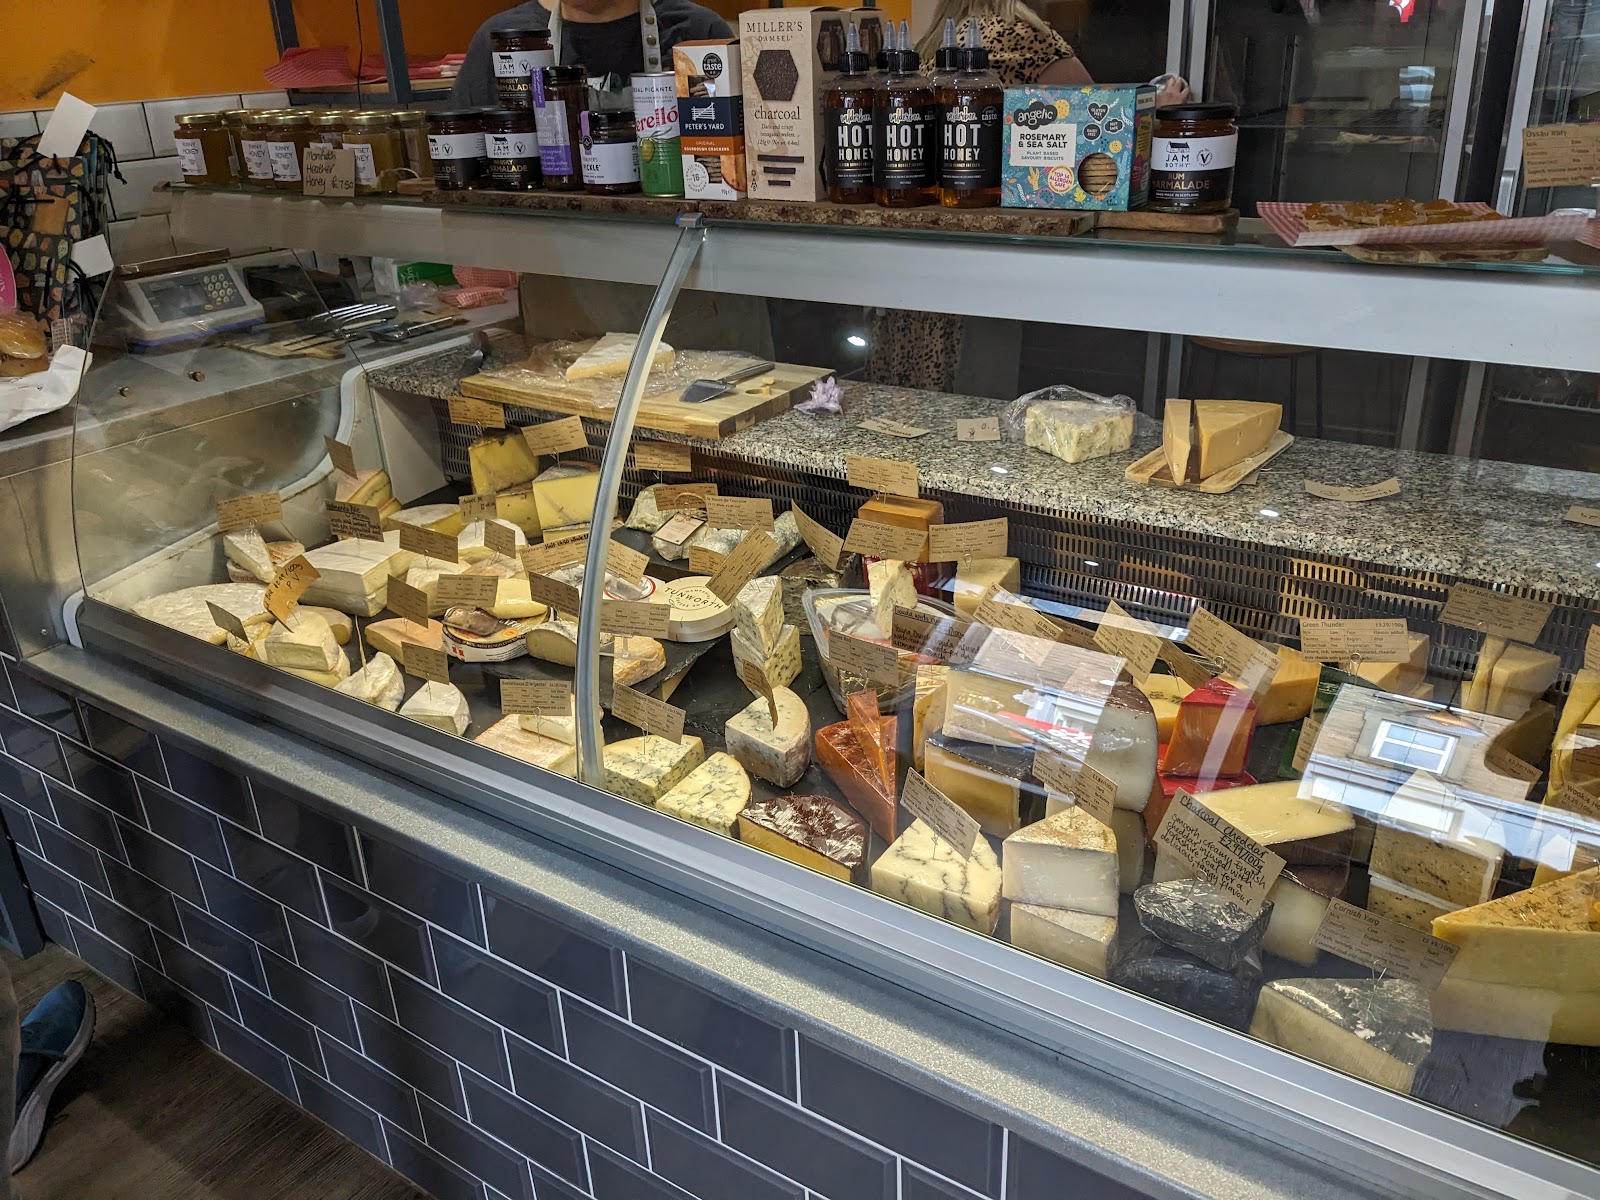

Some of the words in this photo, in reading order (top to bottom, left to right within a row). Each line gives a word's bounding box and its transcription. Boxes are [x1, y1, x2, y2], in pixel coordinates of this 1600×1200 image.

[746, 20, 803, 32] MILLER'S
[703, 62, 722, 71] taste
[636, 105, 679, 132] erelló
[754, 106, 801, 120] charcoal
[981, 113, 998, 121] taste
[1018, 108, 1054, 125] angelic
[780, 124, 794, 132] crispy
[1526, 130, 1549, 138] Ossau
[886, 124, 925, 147] HOT
[943, 123, 982, 147] HOT
[1020, 133, 1067, 141] ROSEMARY
[1046, 141, 1068, 149] SALT
[355, 154, 370, 162] NEY
[886, 148, 924, 161] HONEY
[943, 148, 981, 161] HONEY
[1166, 154, 1190, 162] JAM
[306, 163, 336, 175] Heather
[692, 173, 700, 182] 16
[1049, 175, 1073, 184] ALLERGEN
[305, 176, 326, 194] Honey
[664, 587, 724, 610] TUNWORTH
[1457, 586, 1468, 594] Isle
[1476, 590, 1489, 599] Mull
[1206, 614, 1220, 627] Devil
[1302, 621, 1319, 629] Green
[1567, 784, 1591, 804] Wookie
[1179, 794, 1221, 829] Charcoal
[1223, 825, 1268, 859] Cheddar
[1165, 825, 1200, 858] Yorkshire
[1201, 854, 1220, 872] coal
[1220, 870, 1236, 885] for
[1235, 882, 1243, 891] a
[1167, 820, 1201, 847] cheddar
[1200, 844, 1231, 871] infused
[1230, 866, 1253, 889] with
[1218, 835, 1264, 875] £2.99/100g
[1202, 838, 1233, 867] creamy
[1233, 860, 1267, 890] English
[1196, 860, 1220, 886] tangy
[1218, 880, 1252, 906] flavour
[1333, 902, 1362, 919] Cornish
[1363, 914, 1380, 927] Yarg
[1367, 926, 1378, 935] Cow
